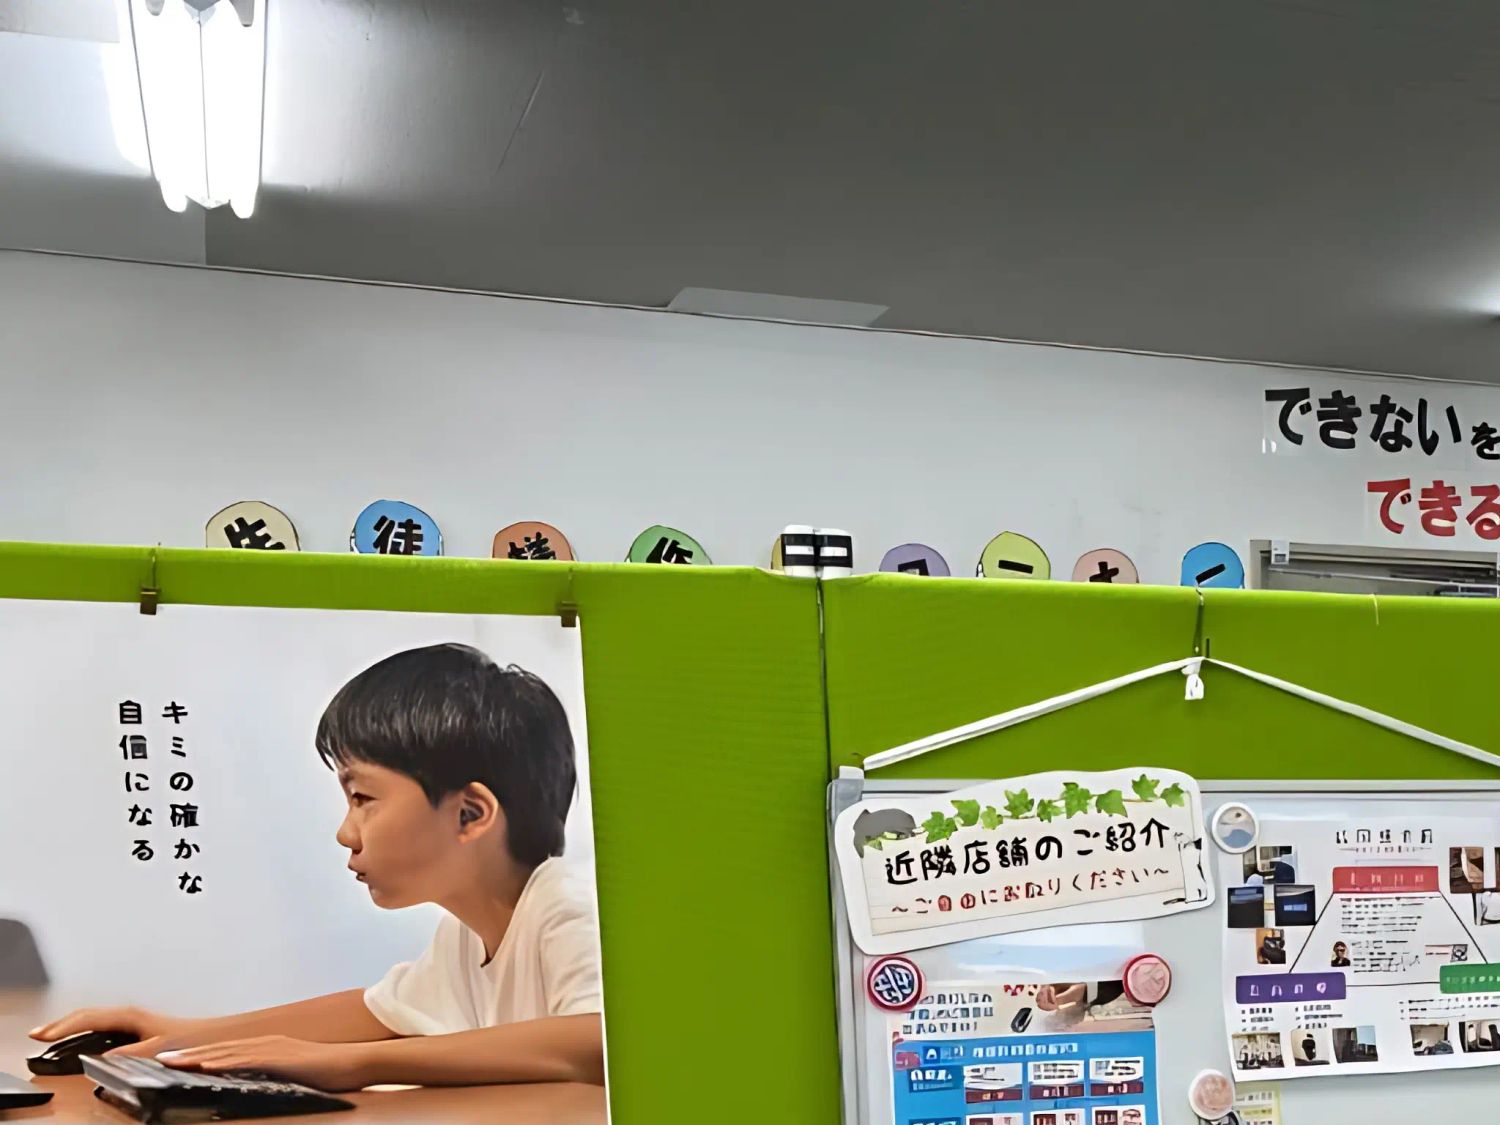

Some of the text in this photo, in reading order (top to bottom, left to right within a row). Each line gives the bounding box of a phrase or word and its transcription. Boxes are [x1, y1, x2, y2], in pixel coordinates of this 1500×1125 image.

[117, 699, 155, 862] 自信になる
[161, 699, 203, 895] キミの確かな
[885, 817, 1171, 886] 近隣店舗のご紹介
